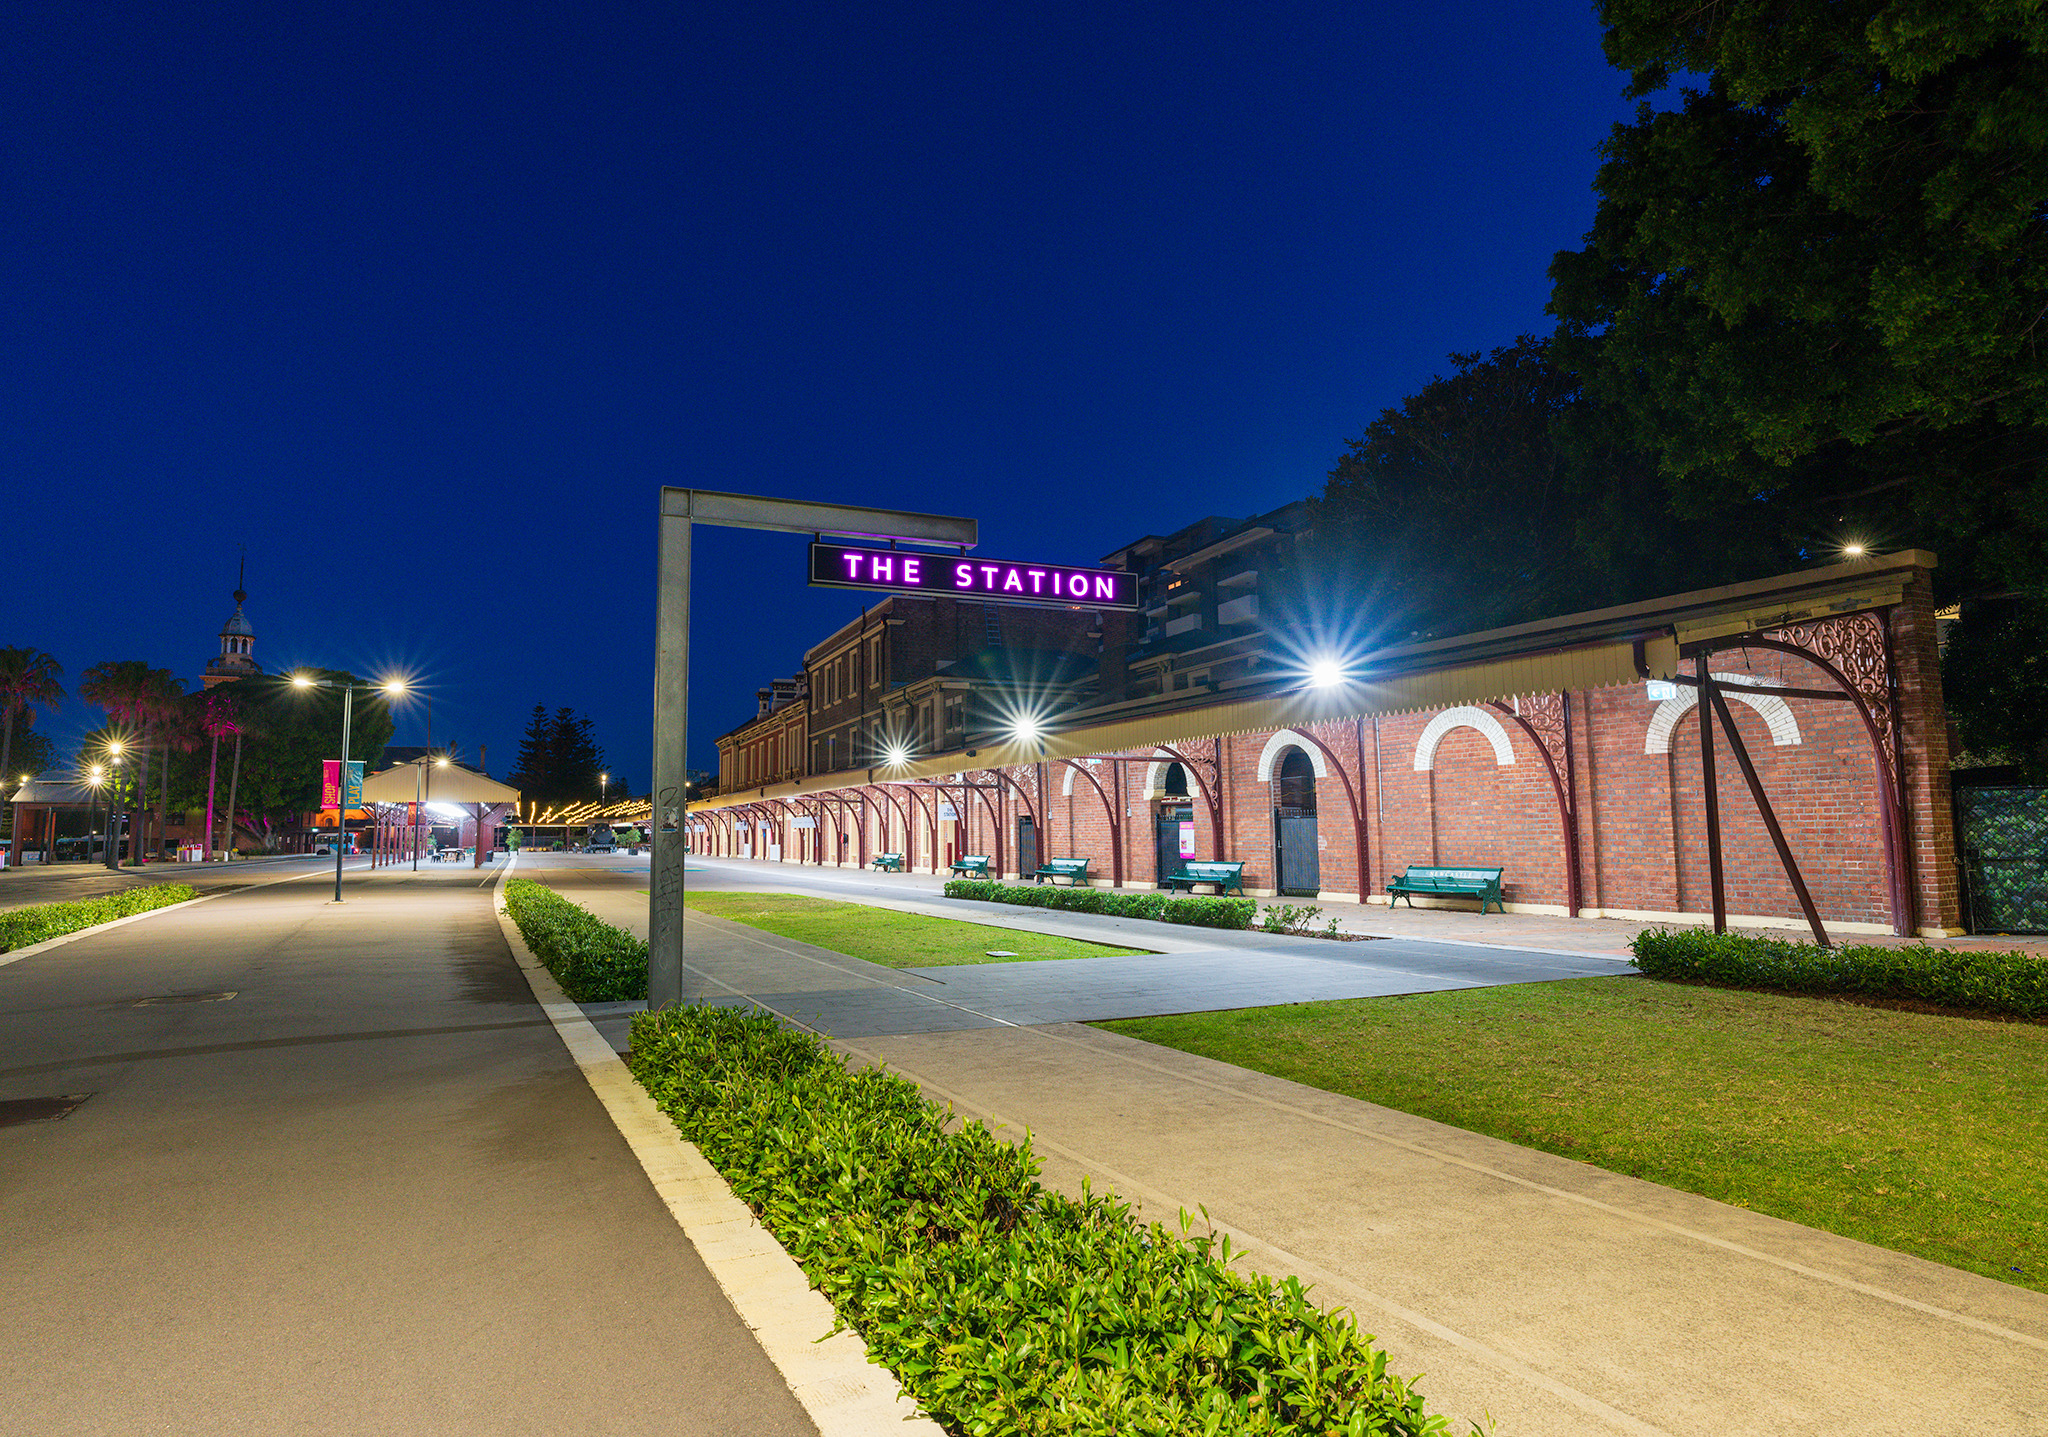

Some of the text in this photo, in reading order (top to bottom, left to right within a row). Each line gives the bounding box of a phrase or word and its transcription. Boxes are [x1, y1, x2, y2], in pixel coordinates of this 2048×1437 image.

[843, 554, 1115, 599] THE STATION
[324, 782, 336, 805] SHOP
[347, 785, 360, 805] PLAY
